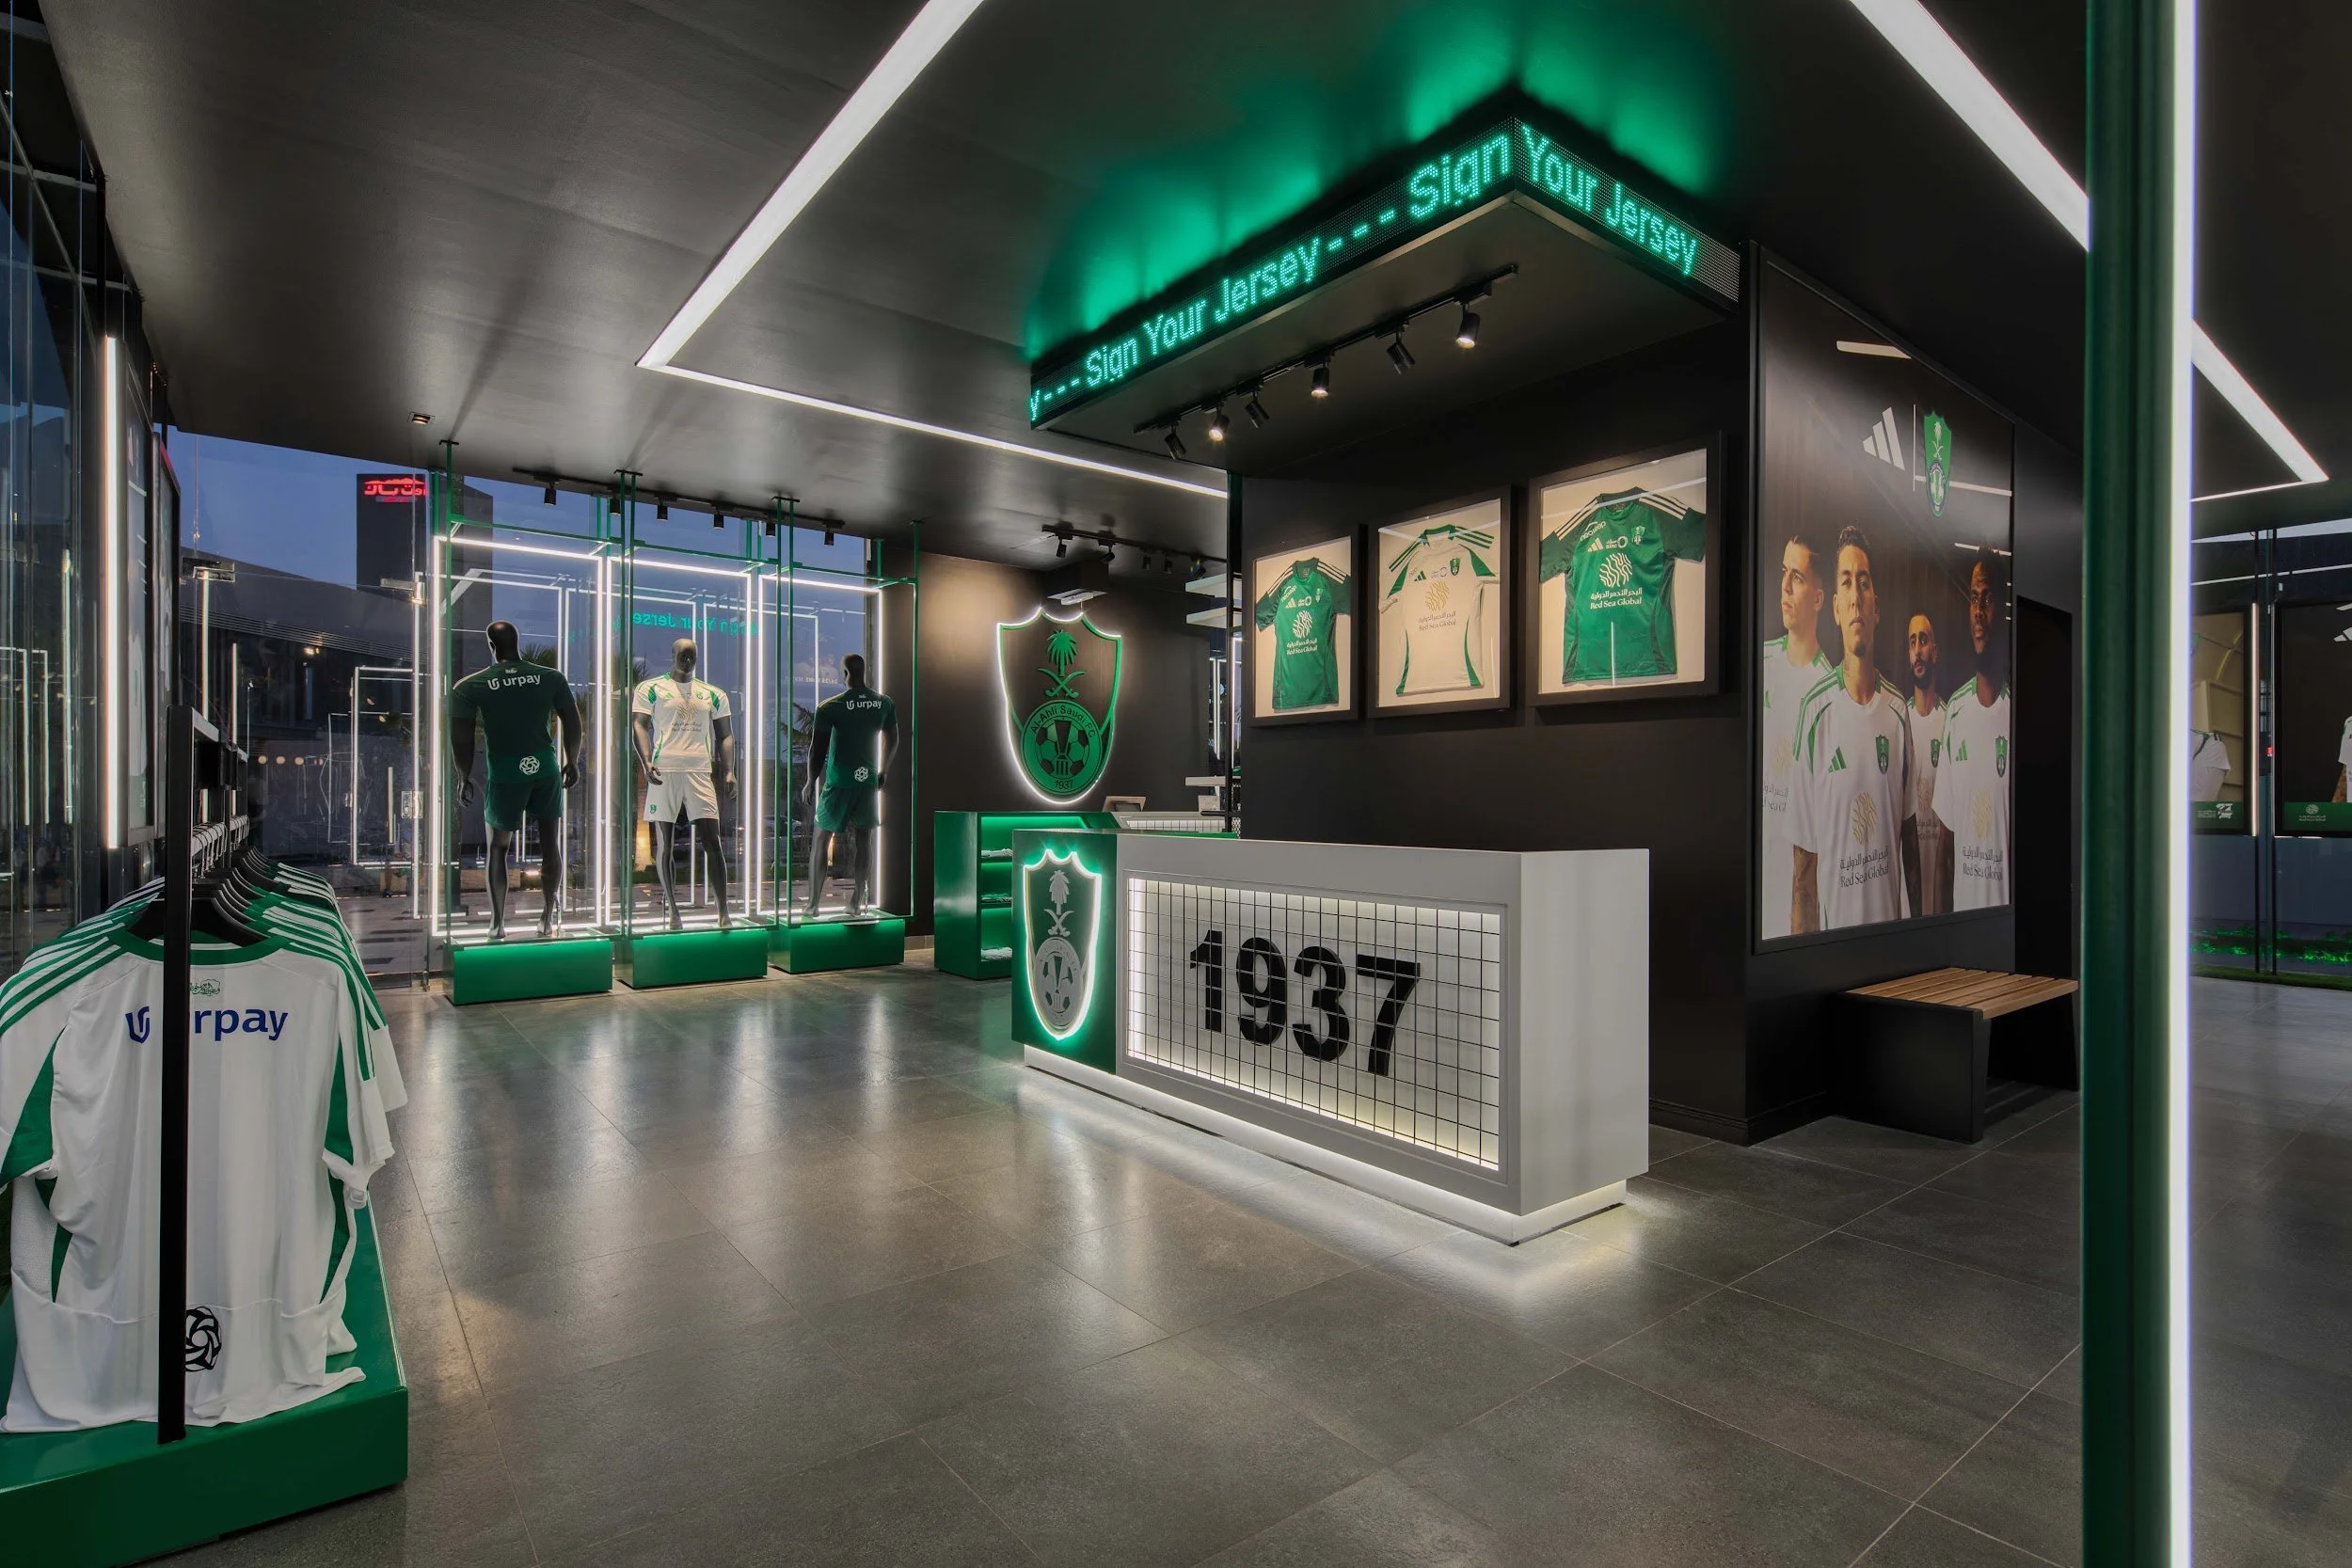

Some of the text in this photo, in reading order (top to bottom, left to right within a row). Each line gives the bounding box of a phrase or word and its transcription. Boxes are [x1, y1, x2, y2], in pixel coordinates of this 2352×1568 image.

[1522, 123, 1697, 276] Your Jersey
[1086, 345, 1137, 387] Sign
[1143, 299, 1206, 355] Your
[1215, 237, 1319, 323] Jersey
[1410, 135, 1509, 217] Sign
[1590, 596, 1643, 610] Red Sea Global
[1419, 624, 1429, 632] Red
[1439, 619, 1456, 628] Global
[502, 674, 541, 687] urpay
[856, 700, 882, 710] urpay
[1031, 705, 1096, 738] Al-Ahli Saudi FC
[1055, 780, 1073, 790] 1937
[1841, 861, 1889, 888] Red Sea Global
[1984, 866, 2003, 881] Global
[1189, 929, 1422, 1077] 1937
[194, 1007, 289, 1041] rpay
